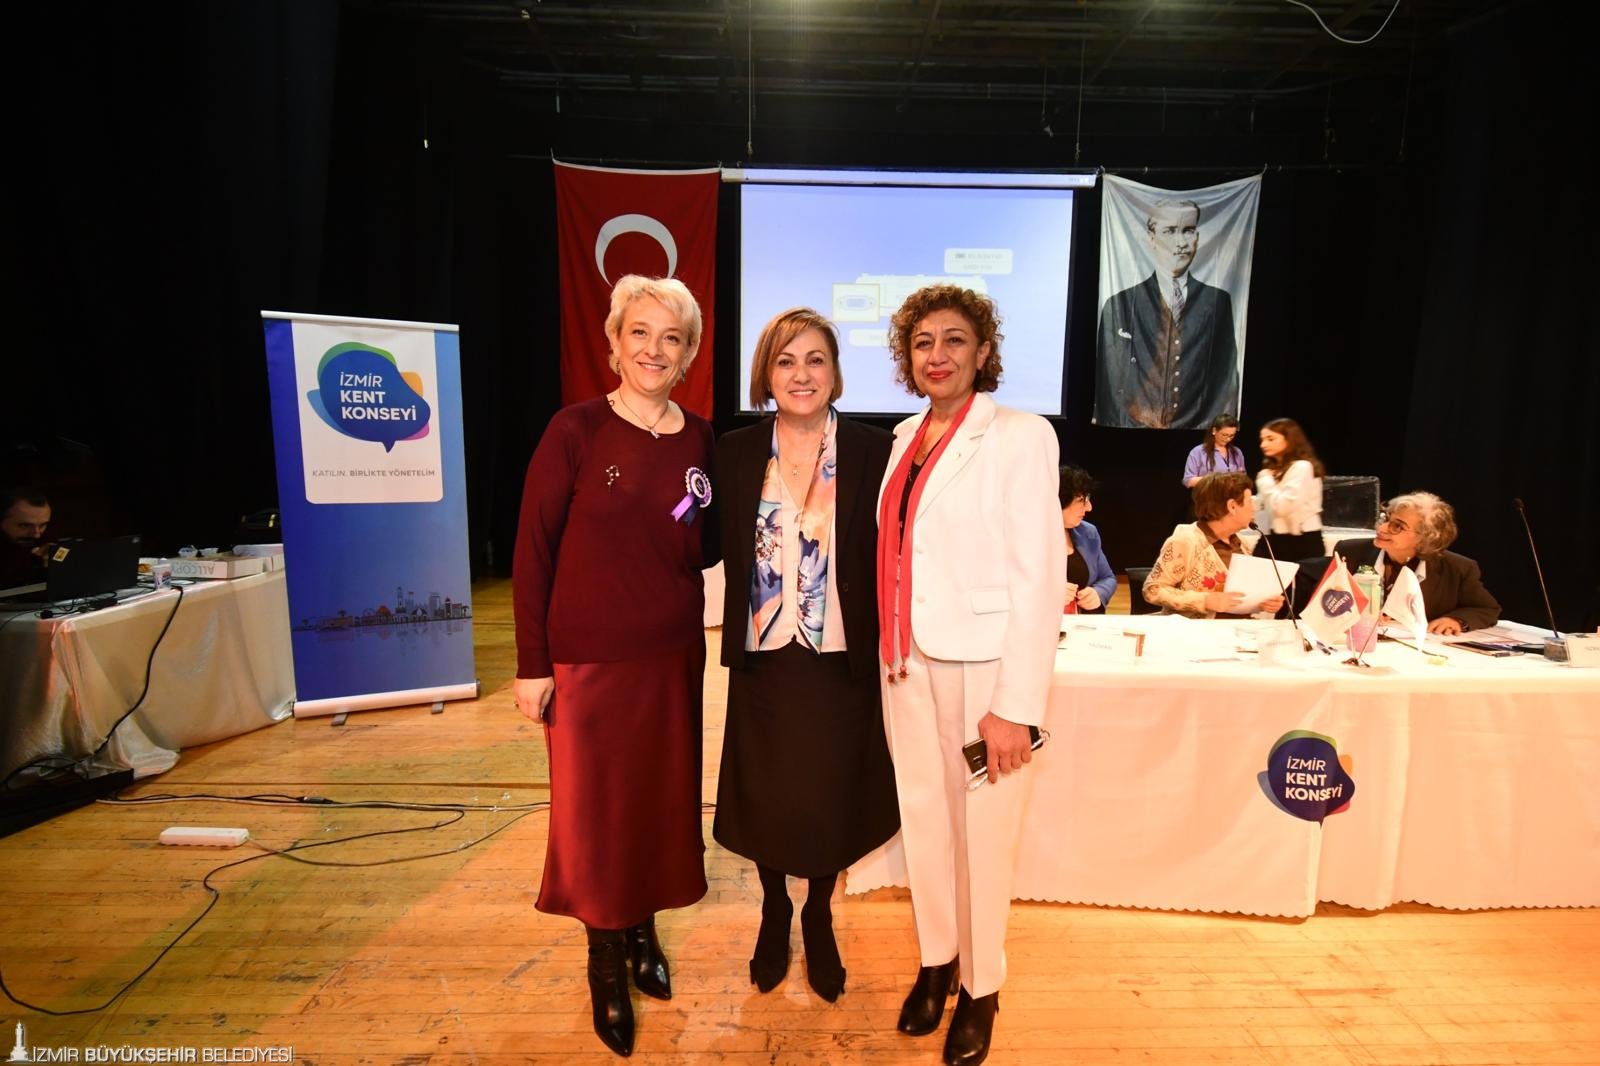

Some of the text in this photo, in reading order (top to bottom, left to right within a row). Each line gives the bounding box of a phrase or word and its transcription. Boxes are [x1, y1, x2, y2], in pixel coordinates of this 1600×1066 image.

[340, 372, 383, 387] İZMİR
[340, 390, 386, 404] KENT
[342, 405, 417, 421] KONSEYİ
[350, 469, 387, 477] BİRLİKTE
[389, 469, 435, 477] YÖNETELİM
[1287, 756, 1326, 771] İZMİR
[1286, 772, 1327, 786] KENT
[1285, 784, 1343, 801] KONSEYİ
